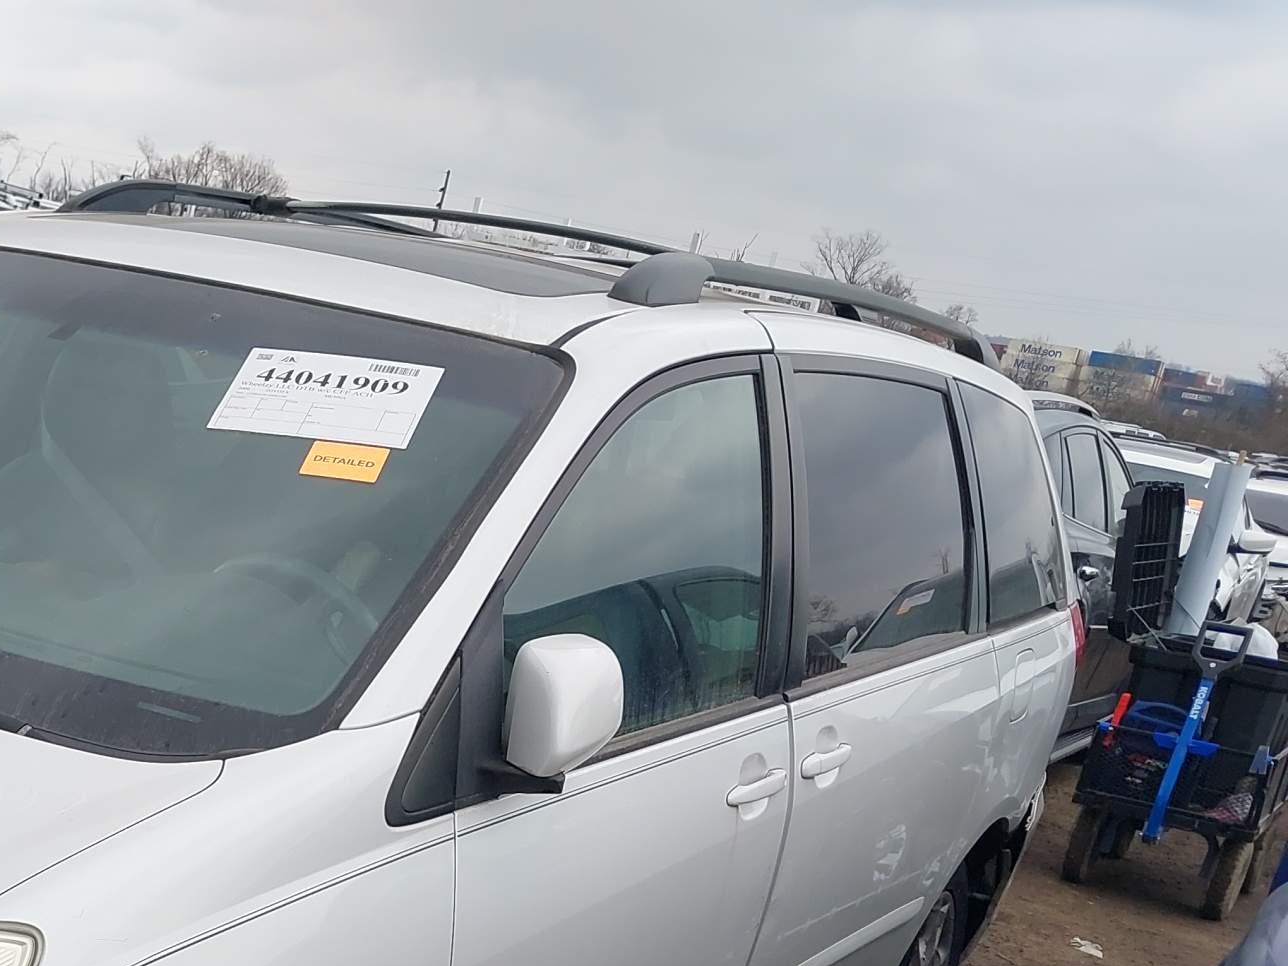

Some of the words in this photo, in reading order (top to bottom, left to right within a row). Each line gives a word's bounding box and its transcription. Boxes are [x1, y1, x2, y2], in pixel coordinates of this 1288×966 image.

[1020, 343, 1062, 358] Matson
[255, 367, 409, 395] 44041909
[312, 454, 376, 468] DETAILED
[1189, 686, 1209, 720] KOBALT
